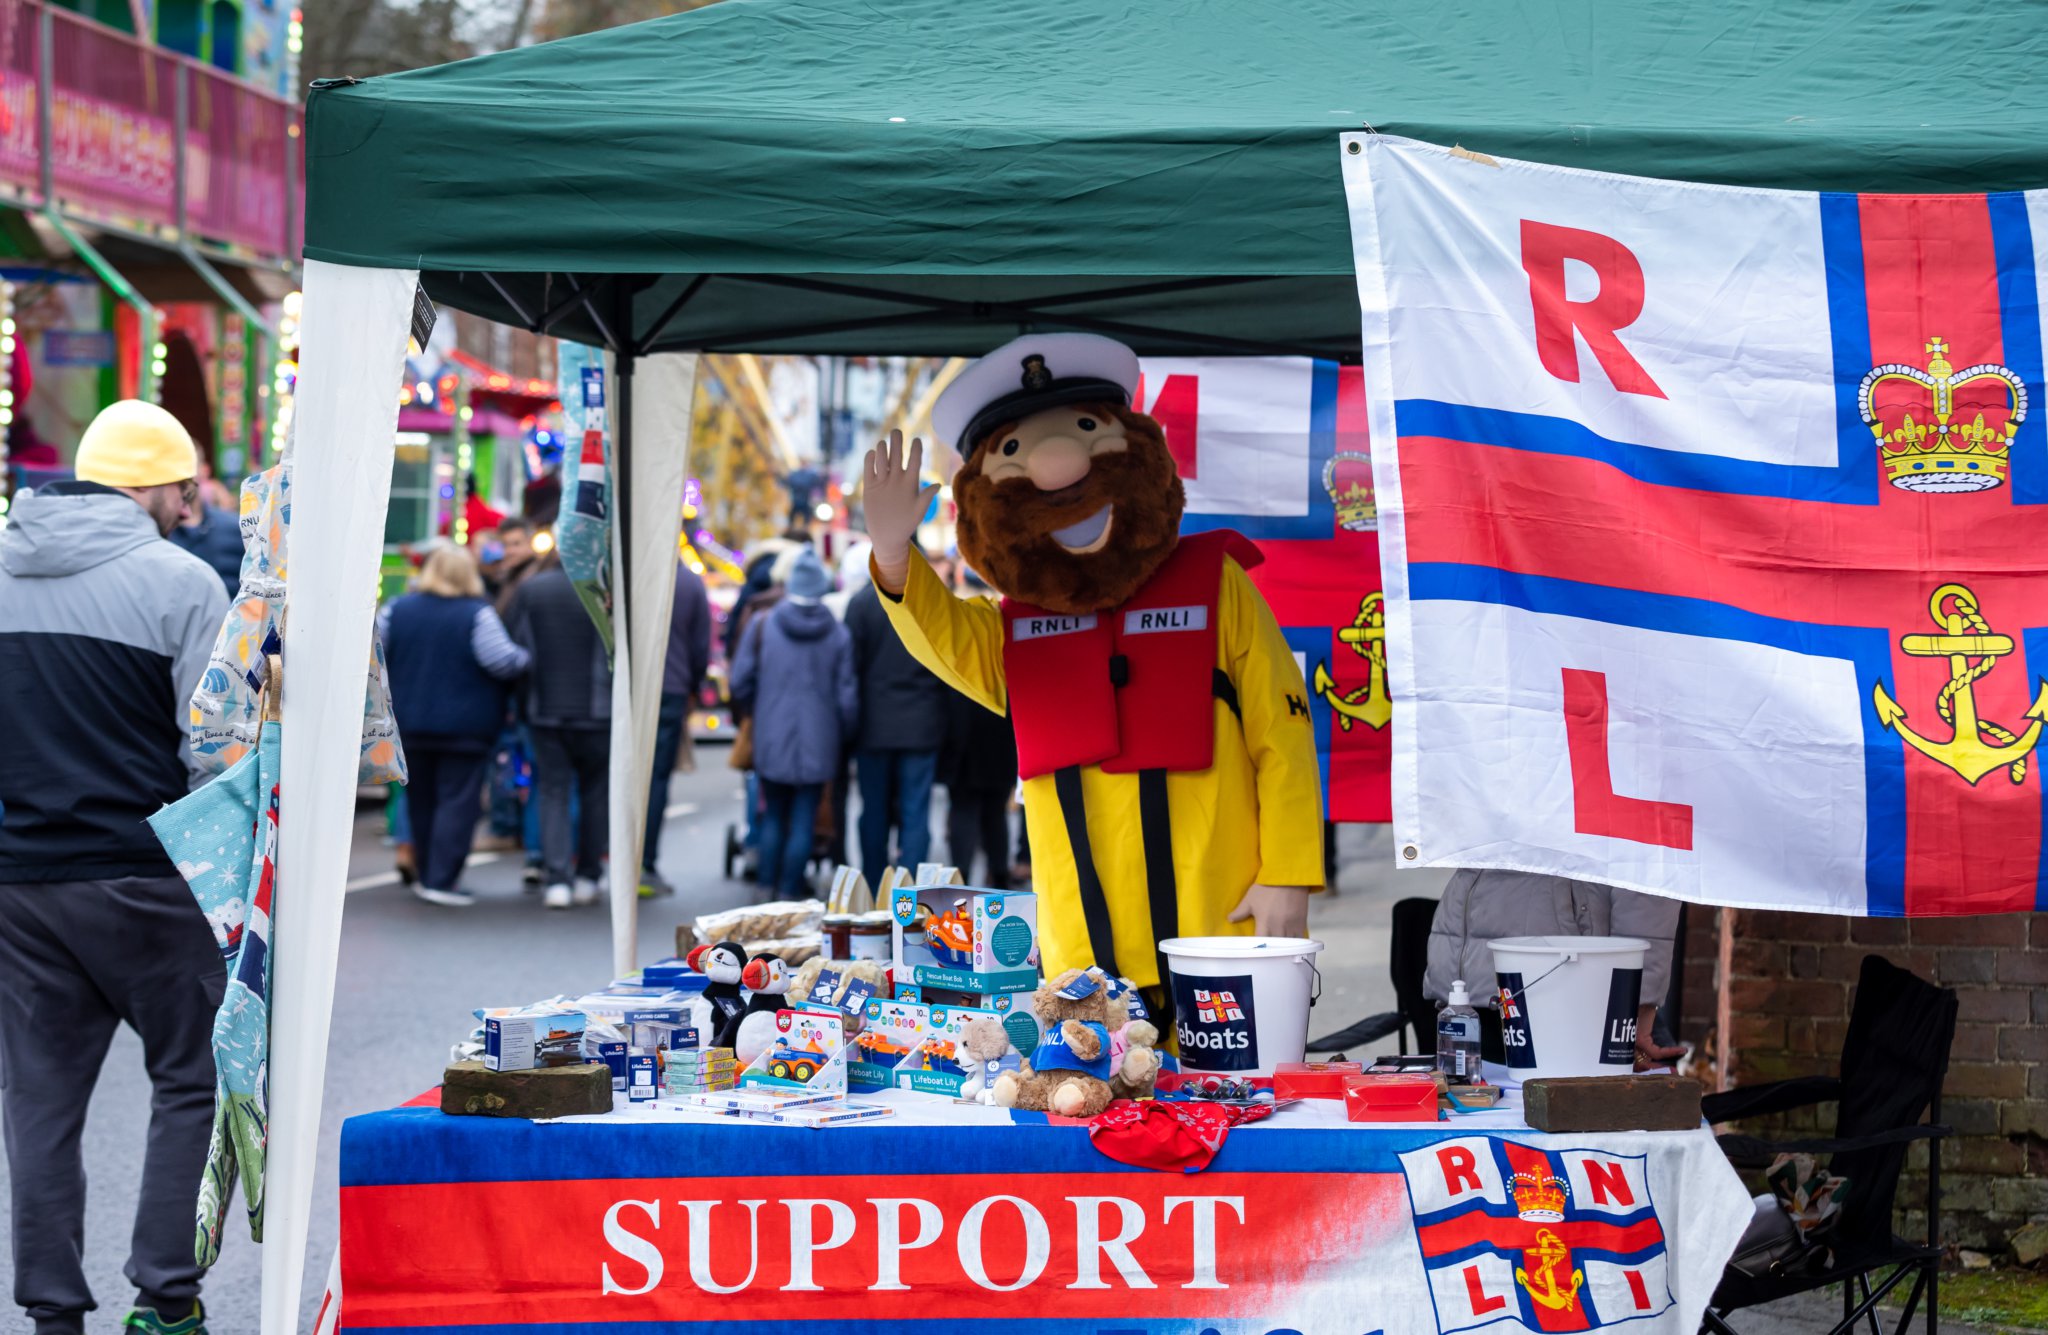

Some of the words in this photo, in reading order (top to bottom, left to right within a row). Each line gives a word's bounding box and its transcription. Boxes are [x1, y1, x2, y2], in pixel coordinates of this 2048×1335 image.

[1520, 218, 1669, 400] R
[1030, 616, 1080, 635] RNLI
[1140, 610, 1189, 629] RNLI
[1561, 667, 1693, 851] L
[896, 901, 913, 915] WOW
[1198, 992, 1206, 1001] R
[1223, 993, 1232, 1001] N
[1204, 1012, 1212, 1021] L
[1177, 1022, 1249, 1049] eboats
[913, 1074, 944, 1086] Lifeboat
[945, 1077, 958, 1089] Lily
[1435, 1145, 1483, 1197] R
[1582, 1159, 1635, 1207] N
[600, 1194, 1246, 1297] SUPPORT
[1463, 1264, 1506, 1316] L
[1623, 1269, 1652, 1310] I
